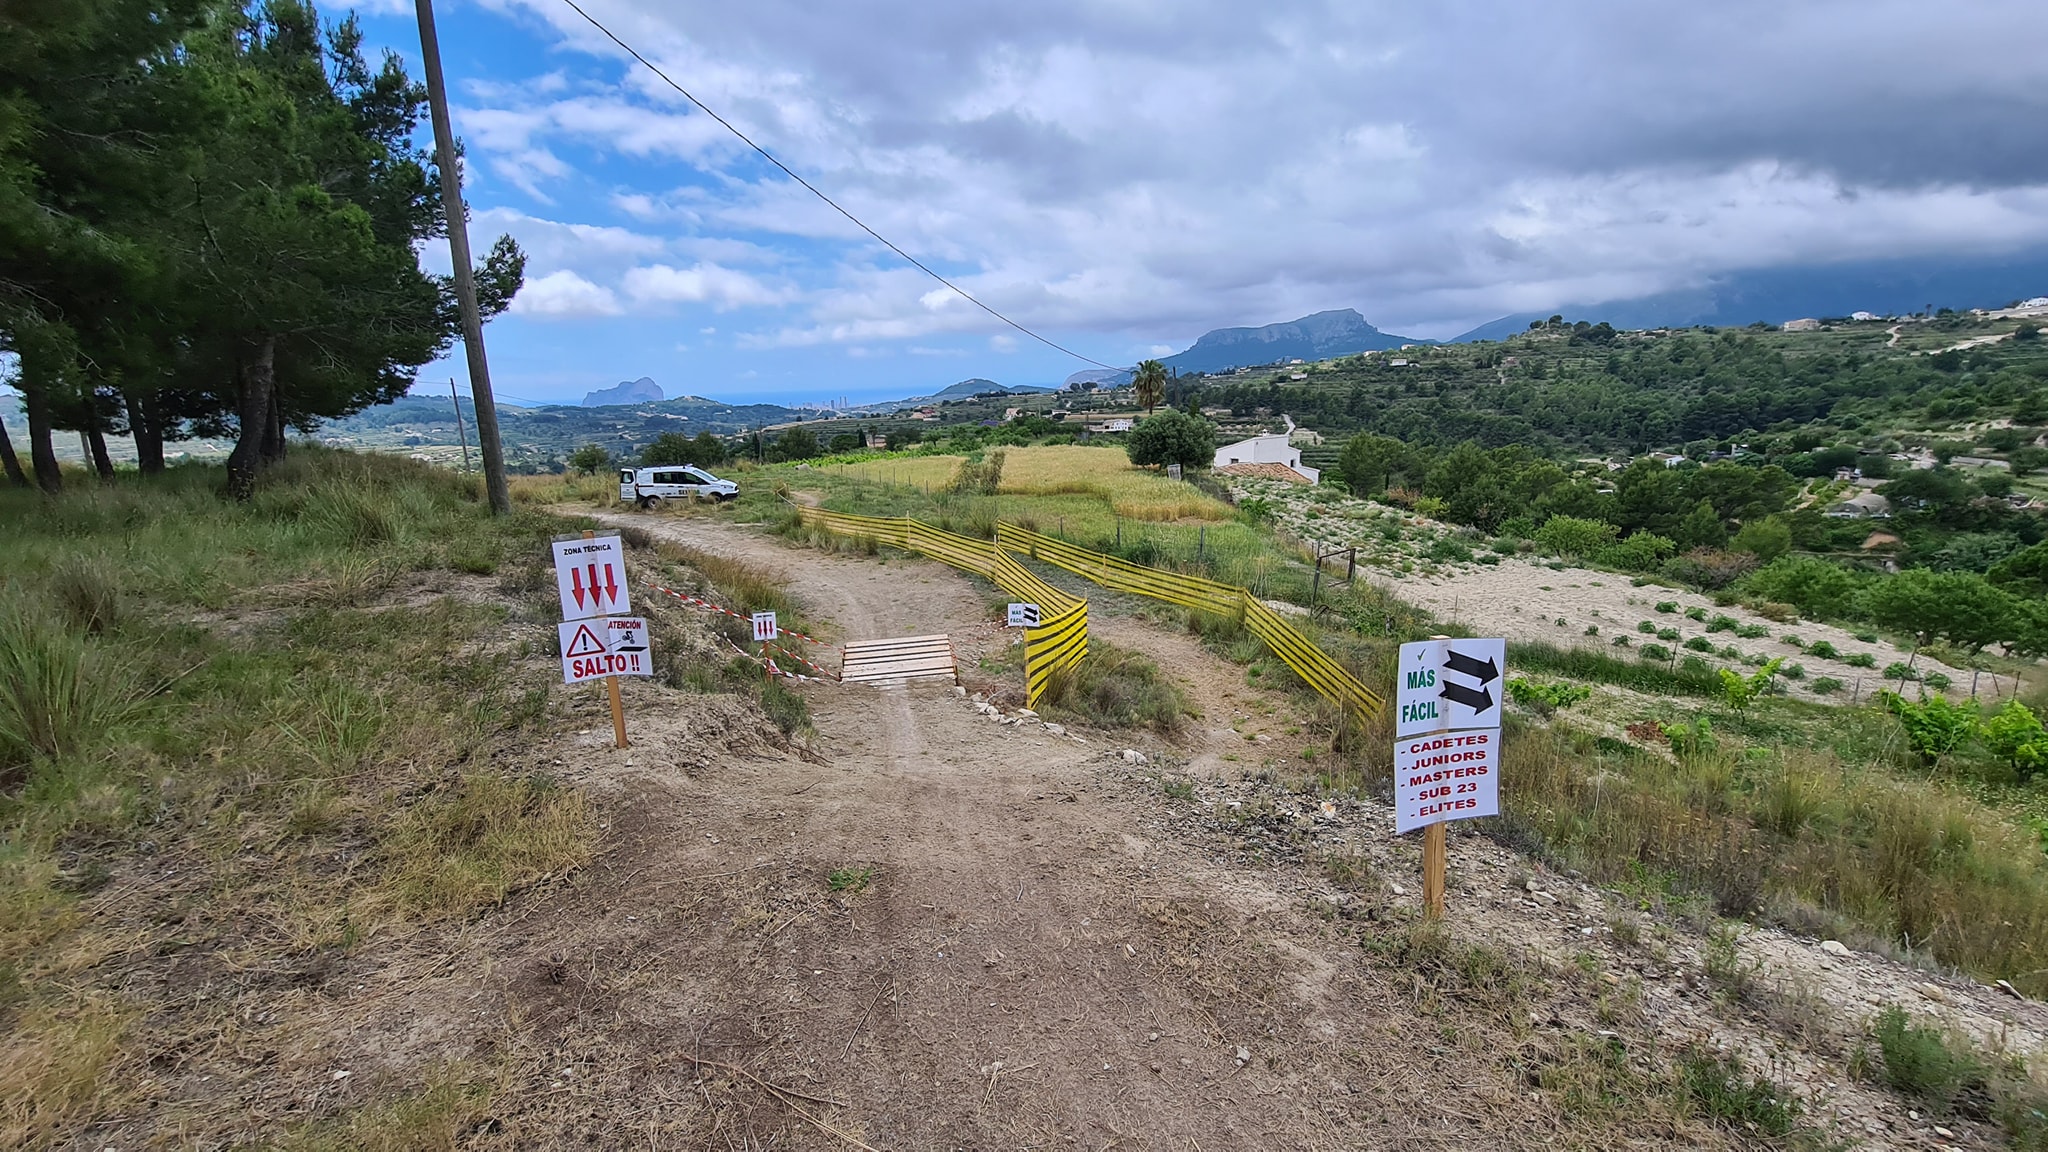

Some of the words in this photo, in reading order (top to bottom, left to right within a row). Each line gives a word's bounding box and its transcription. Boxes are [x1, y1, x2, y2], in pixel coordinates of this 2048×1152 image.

[564, 547, 582, 555] ZONA
[583, 544, 611, 552] TÉCNICA
[608, 620, 641, 629] ATENCIÓN
[573, 654, 627, 678] SALTO
[630, 654, 640, 671] !!
[1407, 666, 1435, 689] MÁS
[1402, 700, 1438, 723] FÁCIL
[1410, 735, 1488, 753] CADETES
[1411, 750, 1486, 770] JUNIORS
[1410, 766, 1488, 787] MASTERS
[1419, 786, 1451, 800] SUB
[1457, 782, 1477, 793] 23
[1419, 798, 1477, 816] ELITES
